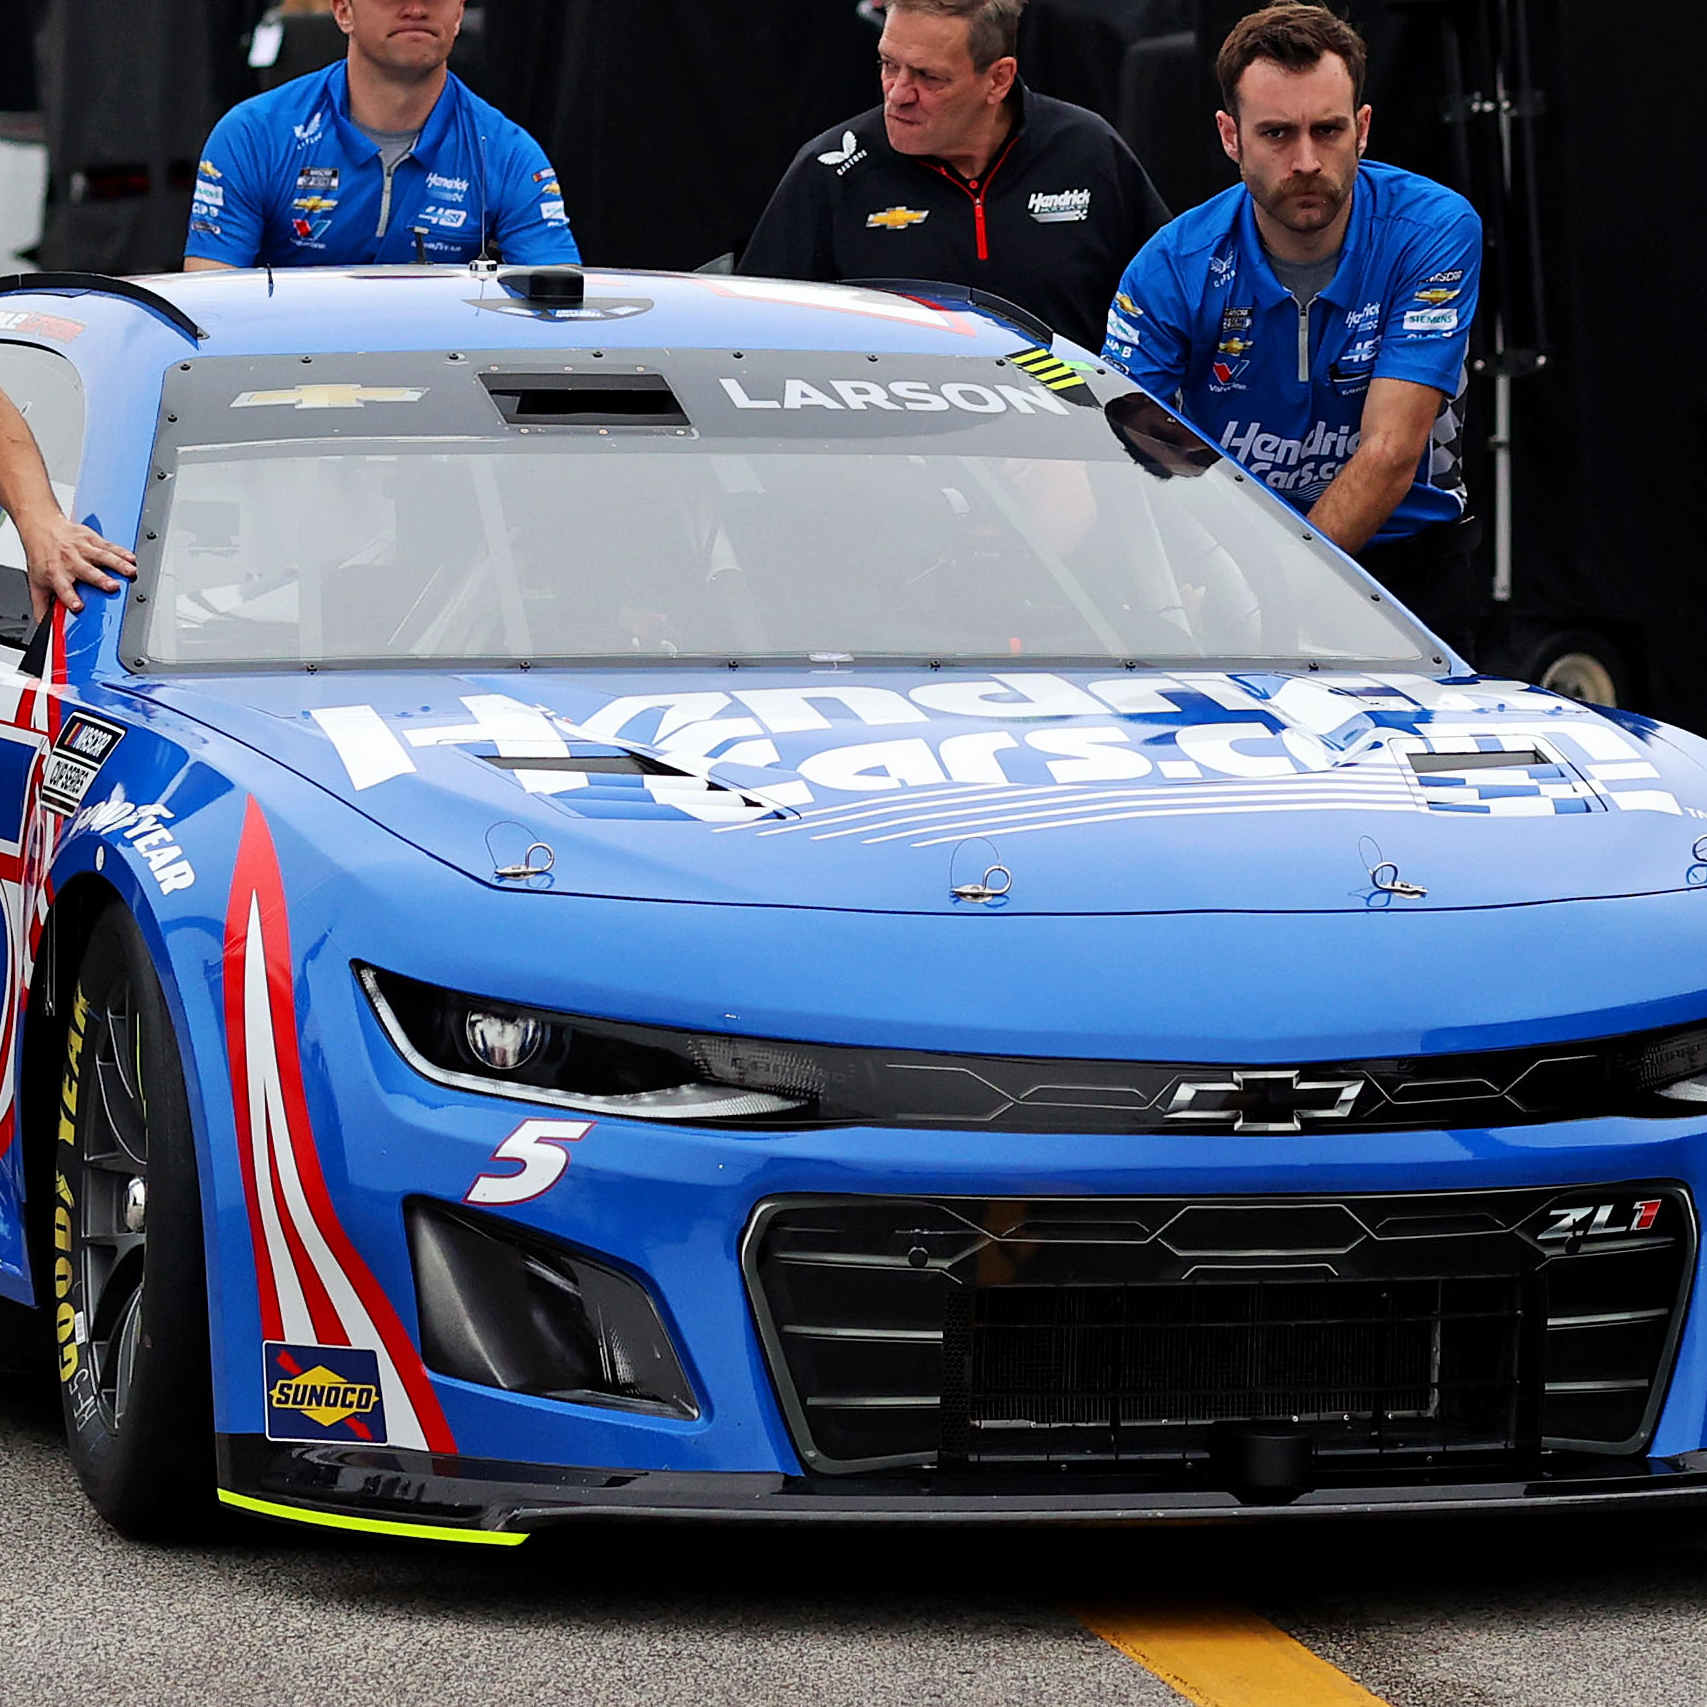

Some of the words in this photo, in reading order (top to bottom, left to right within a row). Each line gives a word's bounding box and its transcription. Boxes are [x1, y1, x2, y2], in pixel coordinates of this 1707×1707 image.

[1028, 189, 1091, 213] Hendrick
[1409, 314, 1452, 324] SIEMENS
[719, 378, 1071, 416] LARSON
[1220, 421, 1362, 465] Hendric
[74, 725, 113, 758] NASCAR
[50, 761, 69, 787] CUP
[61, 765, 90, 795] SERIES
[68, 800, 196, 896] GOODYEAR
[463, 1117, 597, 1206] 5
[1537, 1199, 1663, 1240] ZL1
[275, 1383, 373, 1410] SUNOCO
